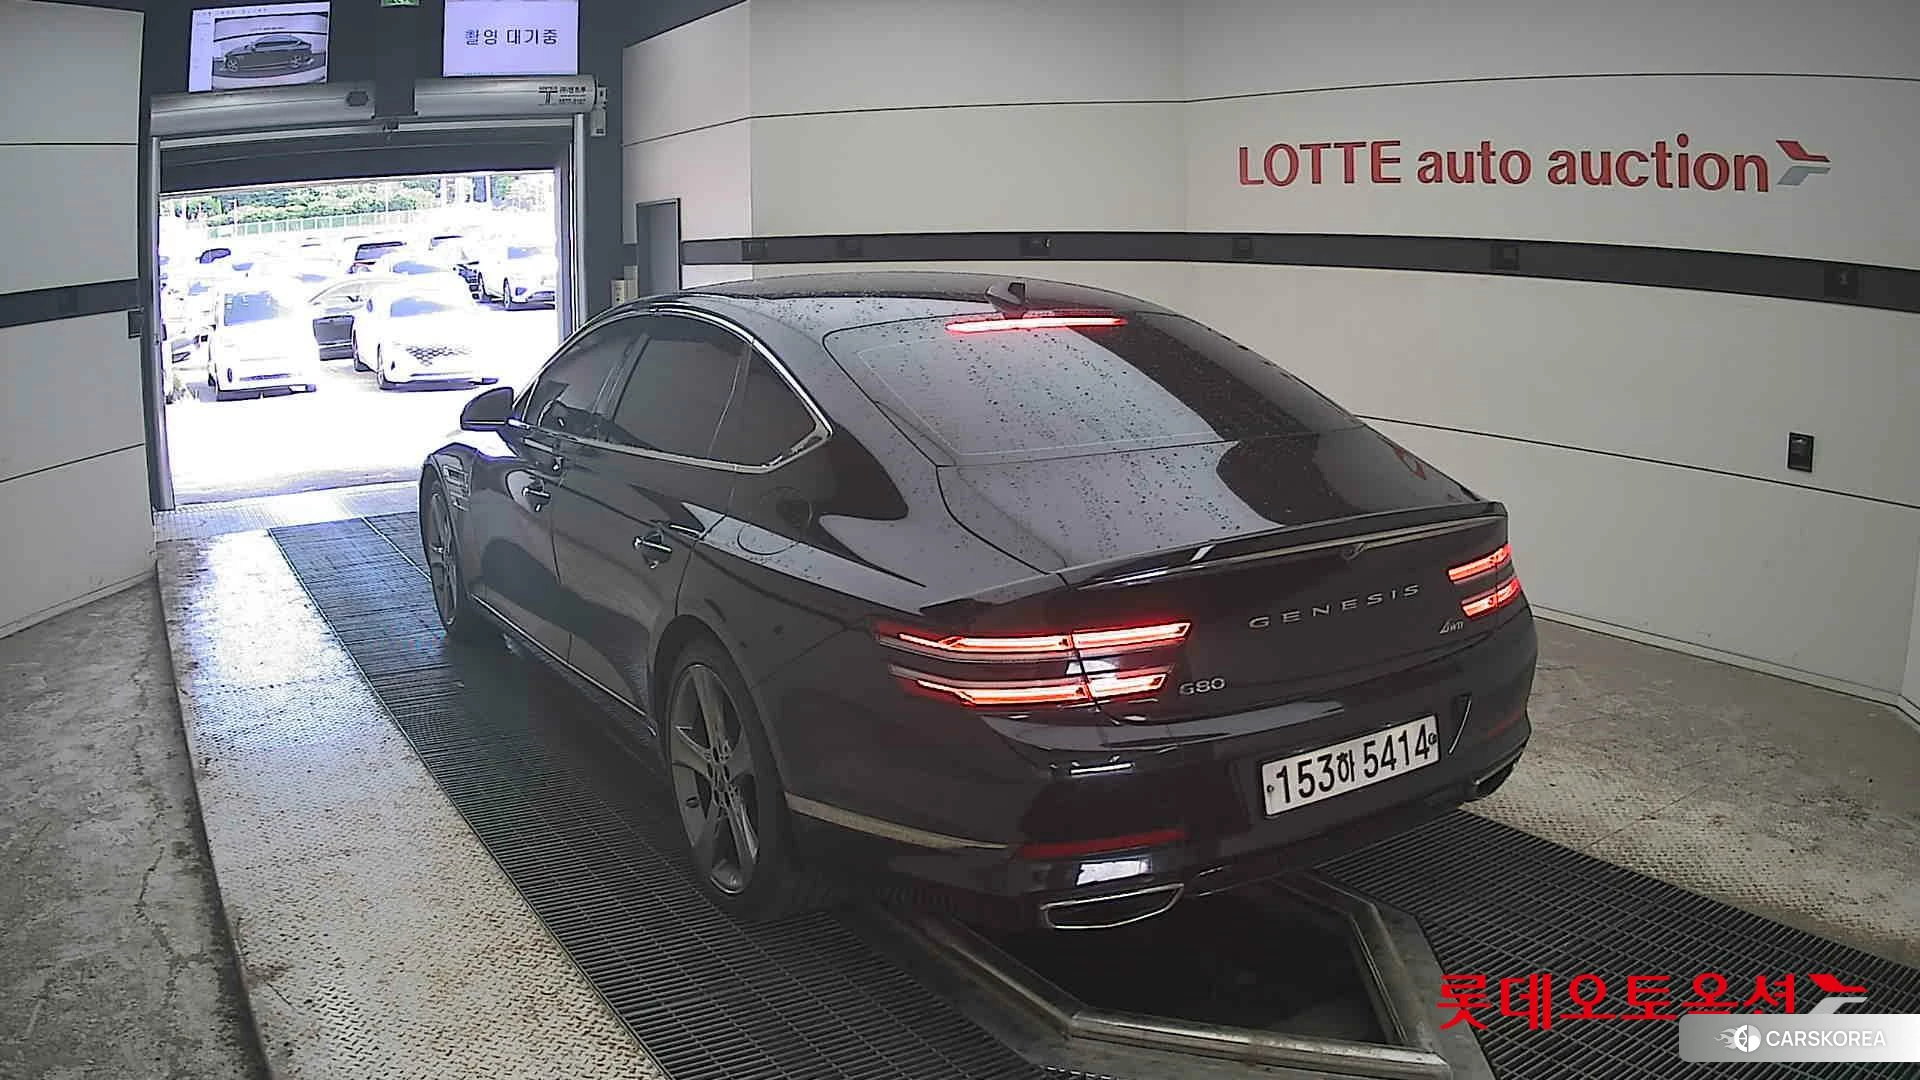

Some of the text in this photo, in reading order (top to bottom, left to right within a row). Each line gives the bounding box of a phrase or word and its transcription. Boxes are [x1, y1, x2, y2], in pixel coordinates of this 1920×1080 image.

[506, 28, 558, 45] 대기중
[1239, 133, 1769, 193] LOTTE auto auction
[1249, 584, 1419, 629] GENESIS
[1179, 677, 1226, 696] G80
[1276, 723, 1431, 804] 153하 5414
